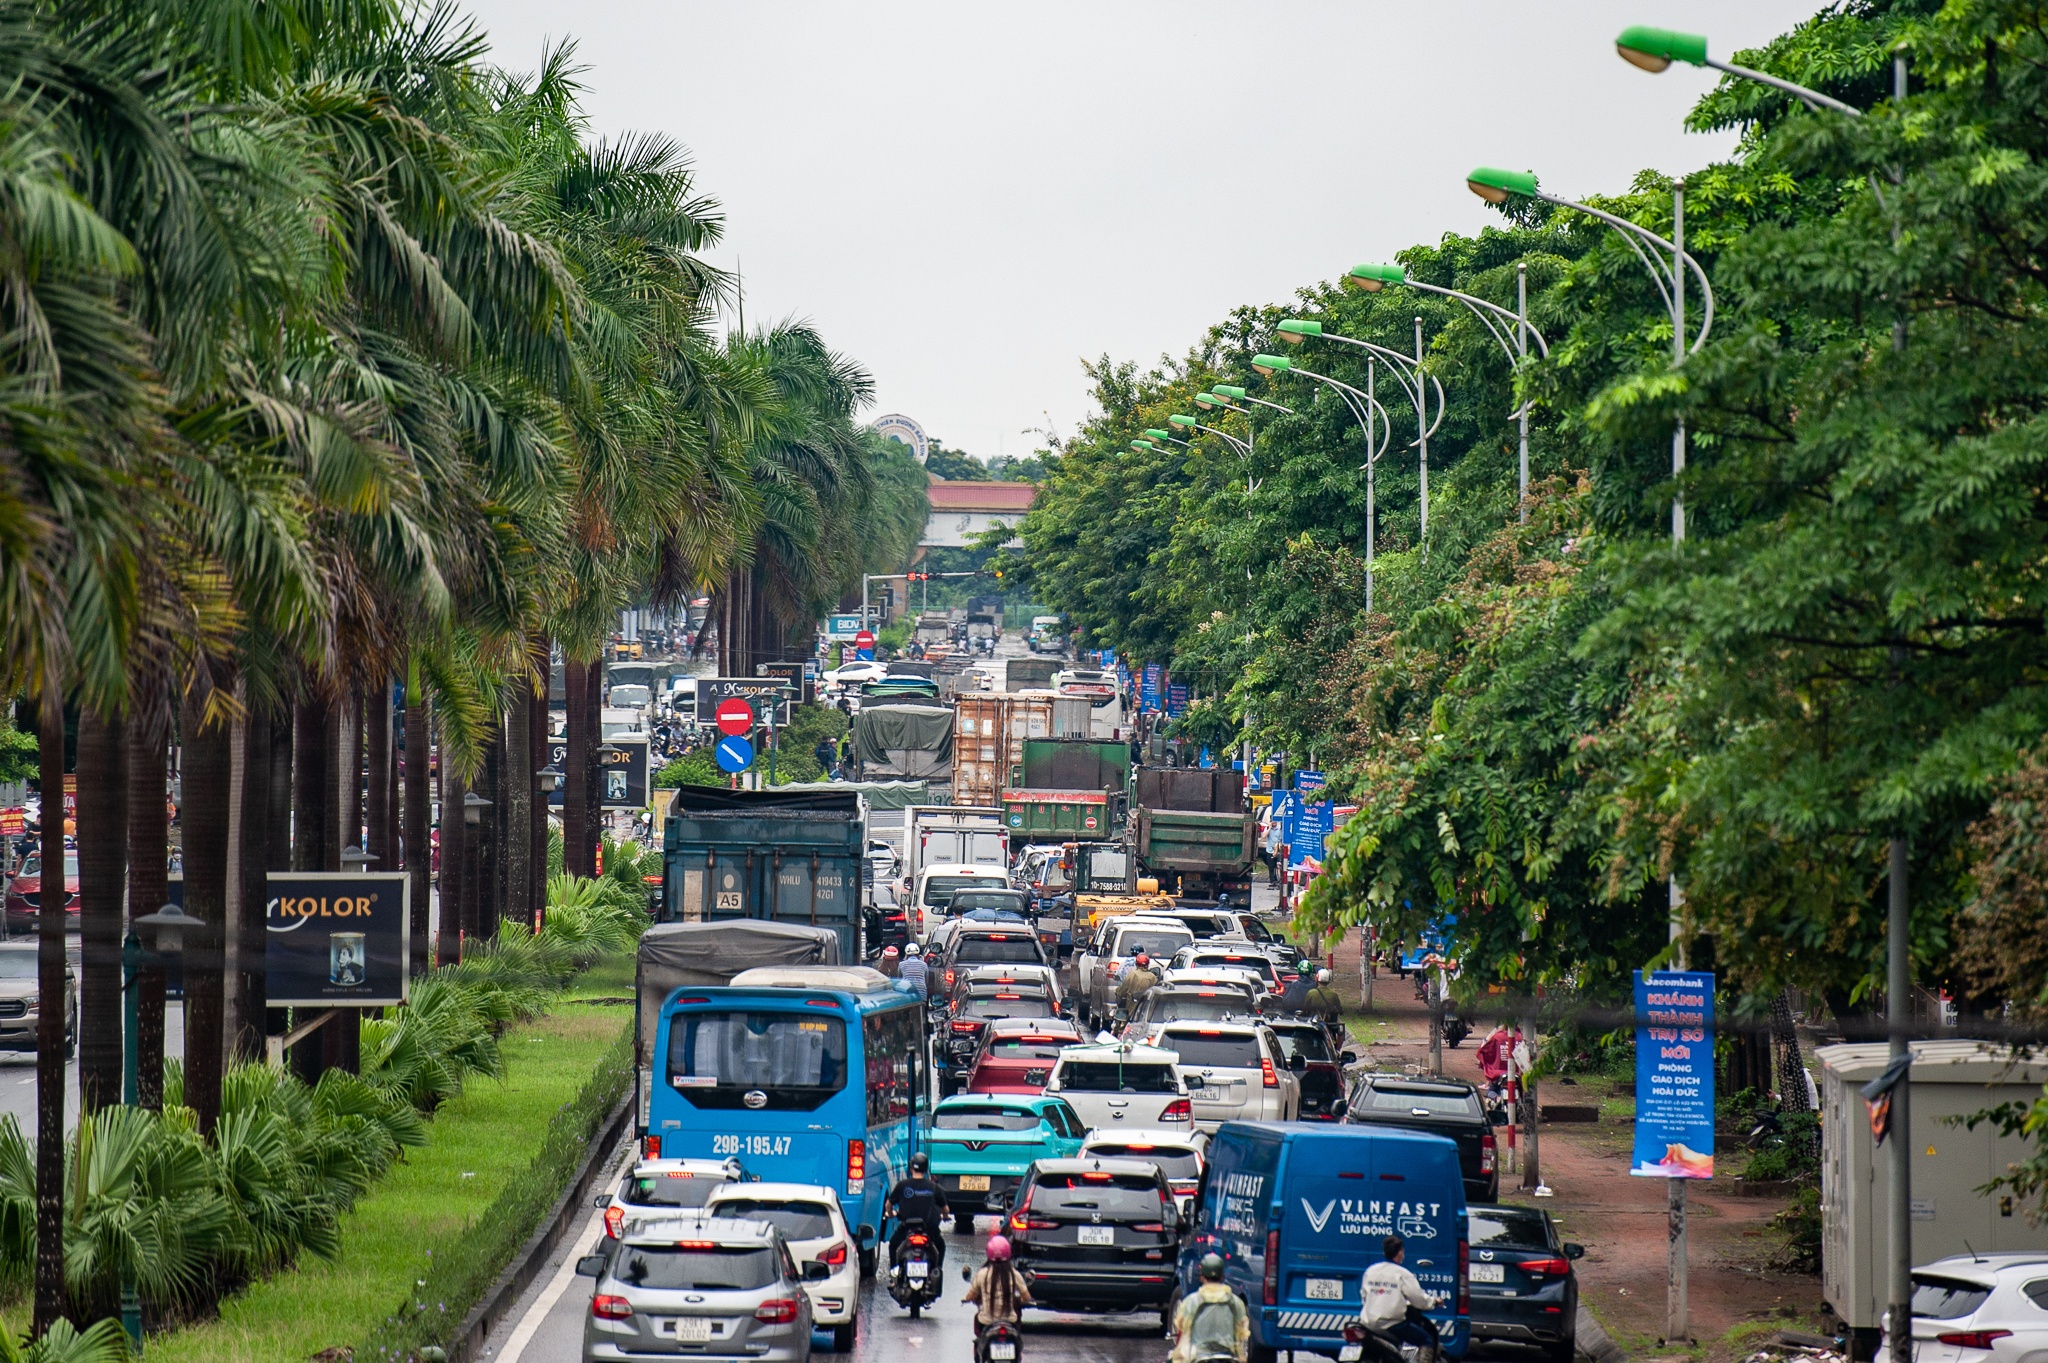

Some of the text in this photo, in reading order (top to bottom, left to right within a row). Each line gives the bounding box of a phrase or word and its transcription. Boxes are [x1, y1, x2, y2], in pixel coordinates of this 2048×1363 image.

[837, 620, 859, 629] BIDV
[780, 875, 801, 886] WHLU
[816, 876, 842, 887] 419433
[720, 894, 739, 907] A5
[816, 889, 834, 900] 42G1
[1644, 976, 1704, 988] Sacombank
[1647, 991, 1704, 1007] KHÁNH
[1648, 1008, 1703, 1025] THÀNH
[1648, 1028, 1678, 1044] TRỤ
[1661, 1045, 1690, 1059] MỚI
[1658, 1062, 1692, 1073] PHÒNG
[1651, 1075, 1700, 1086] GIAO DỊCH
[1652, 1087, 1699, 1097] HOÀI ĐỨC
[713, 1135, 792, 1156] 29B-195.47
[1341, 1199, 1440, 1217] VINFAST
[1340, 1213, 1392, 1225] TRẠM SẠC
[1340, 1224, 1393, 1236] LƯU ĐỘNG
